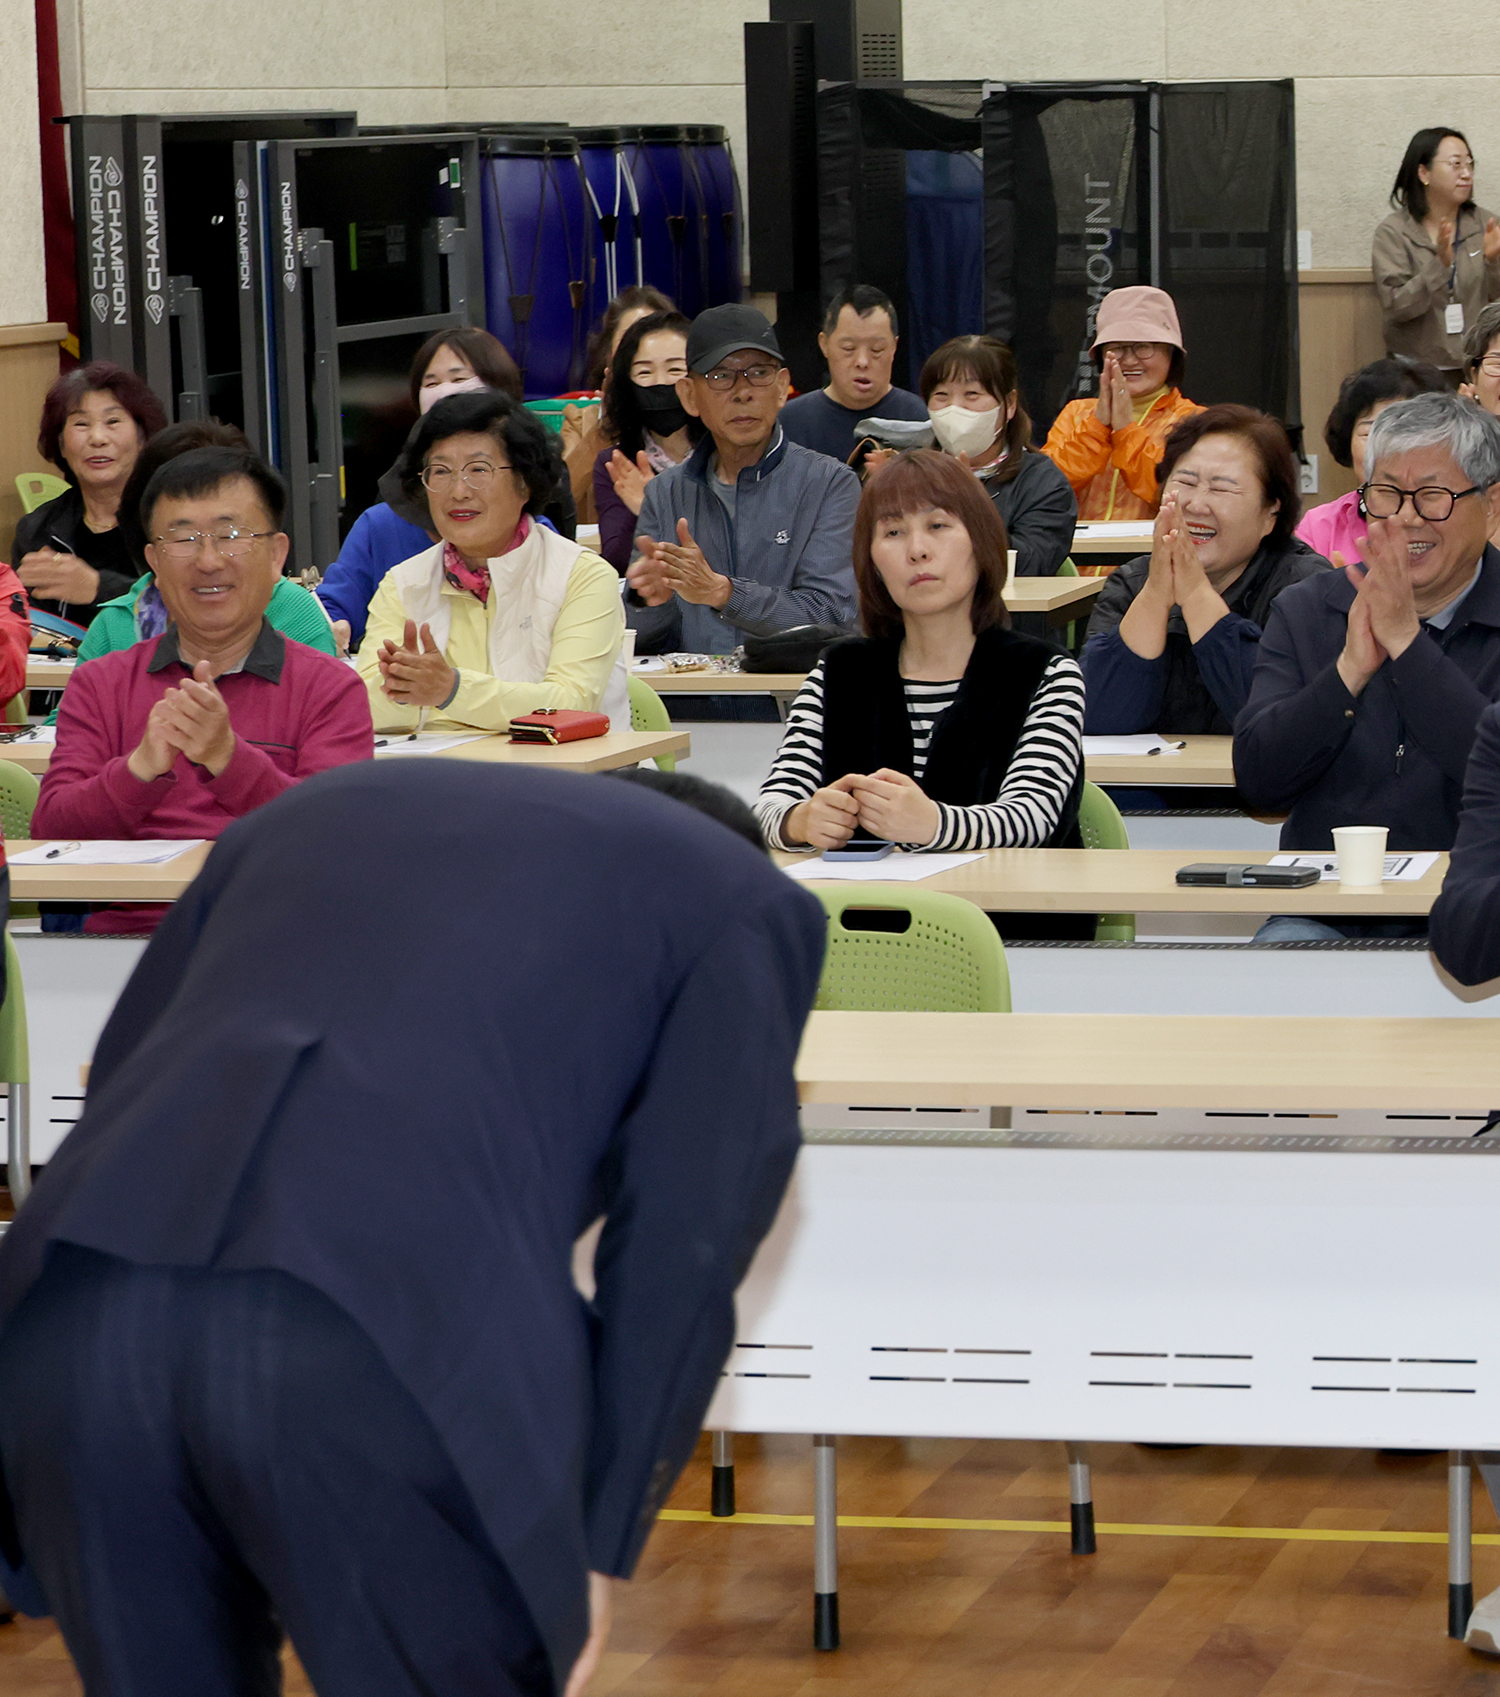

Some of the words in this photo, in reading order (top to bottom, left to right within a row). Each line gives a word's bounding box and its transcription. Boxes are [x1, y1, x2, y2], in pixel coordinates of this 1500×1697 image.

[89, 155, 107, 290] CHAMPION
[107, 190, 127, 325] CHAMPION
[143, 155, 162, 291] CHAMPION
[237, 200, 250, 290] CHAMPION
[281, 181, 295, 271] CHAMPION
